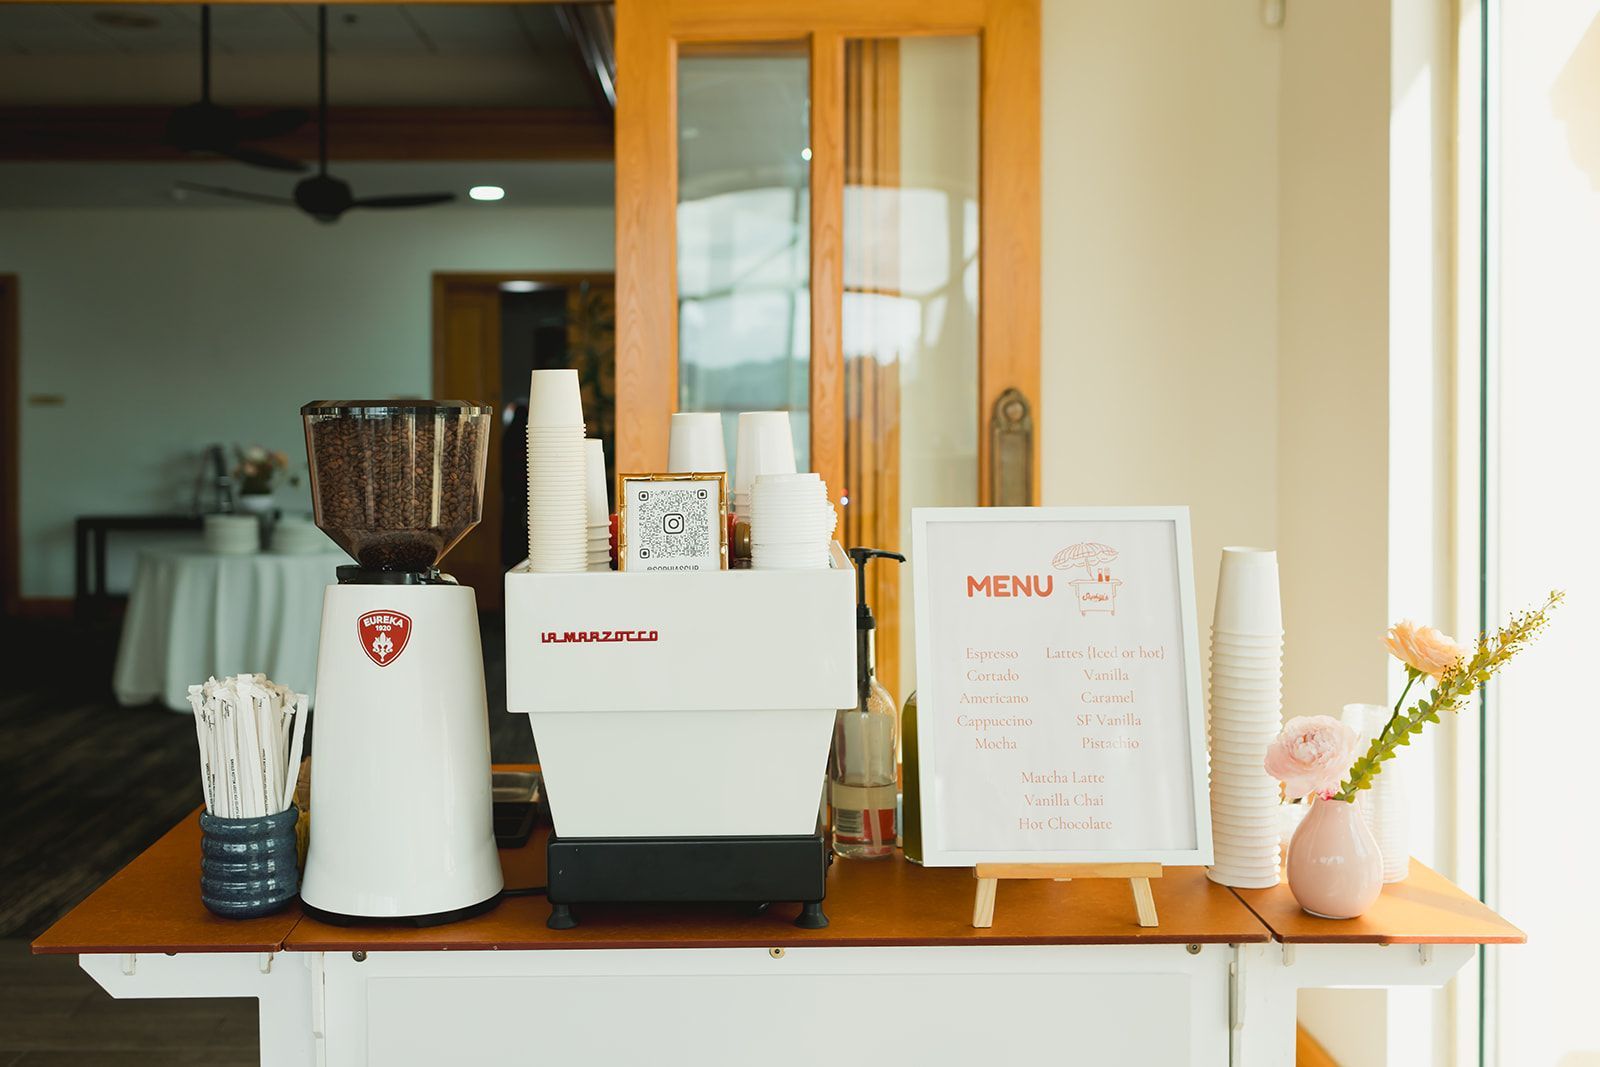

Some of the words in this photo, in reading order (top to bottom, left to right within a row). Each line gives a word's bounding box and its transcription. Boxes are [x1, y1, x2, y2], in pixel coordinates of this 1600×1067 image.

[967, 575, 1054, 597] MENU
[363, 615, 404, 628] EUREKA
[965, 647, 1020, 662] Espresso
[1046, 647, 1084, 660] Lattes
[1121, 650, 1136, 660] or
[966, 669, 1020, 682] Cortado
[1083, 667, 1130, 681] Vanilla
[959, 692, 1030, 704] Americano
[1080, 690, 1136, 704] Caramel
[956, 715, 1034, 729] Cappuccino
[1076, 713, 1092, 727] SF
[1096, 713, 1143, 727] Vanilla
[975, 736, 1018, 750] Mocha
[1081, 736, 1141, 750] Pistachio
[1021, 770, 1069, 785] Matcha
[1071, 770, 1105, 785] Latte
[1024, 793, 1071, 807] Vanilla
[1073, 793, 1105, 807] Chai
[1018, 816, 1044, 831] Hot
[1047, 816, 1113, 831] Chocolate
